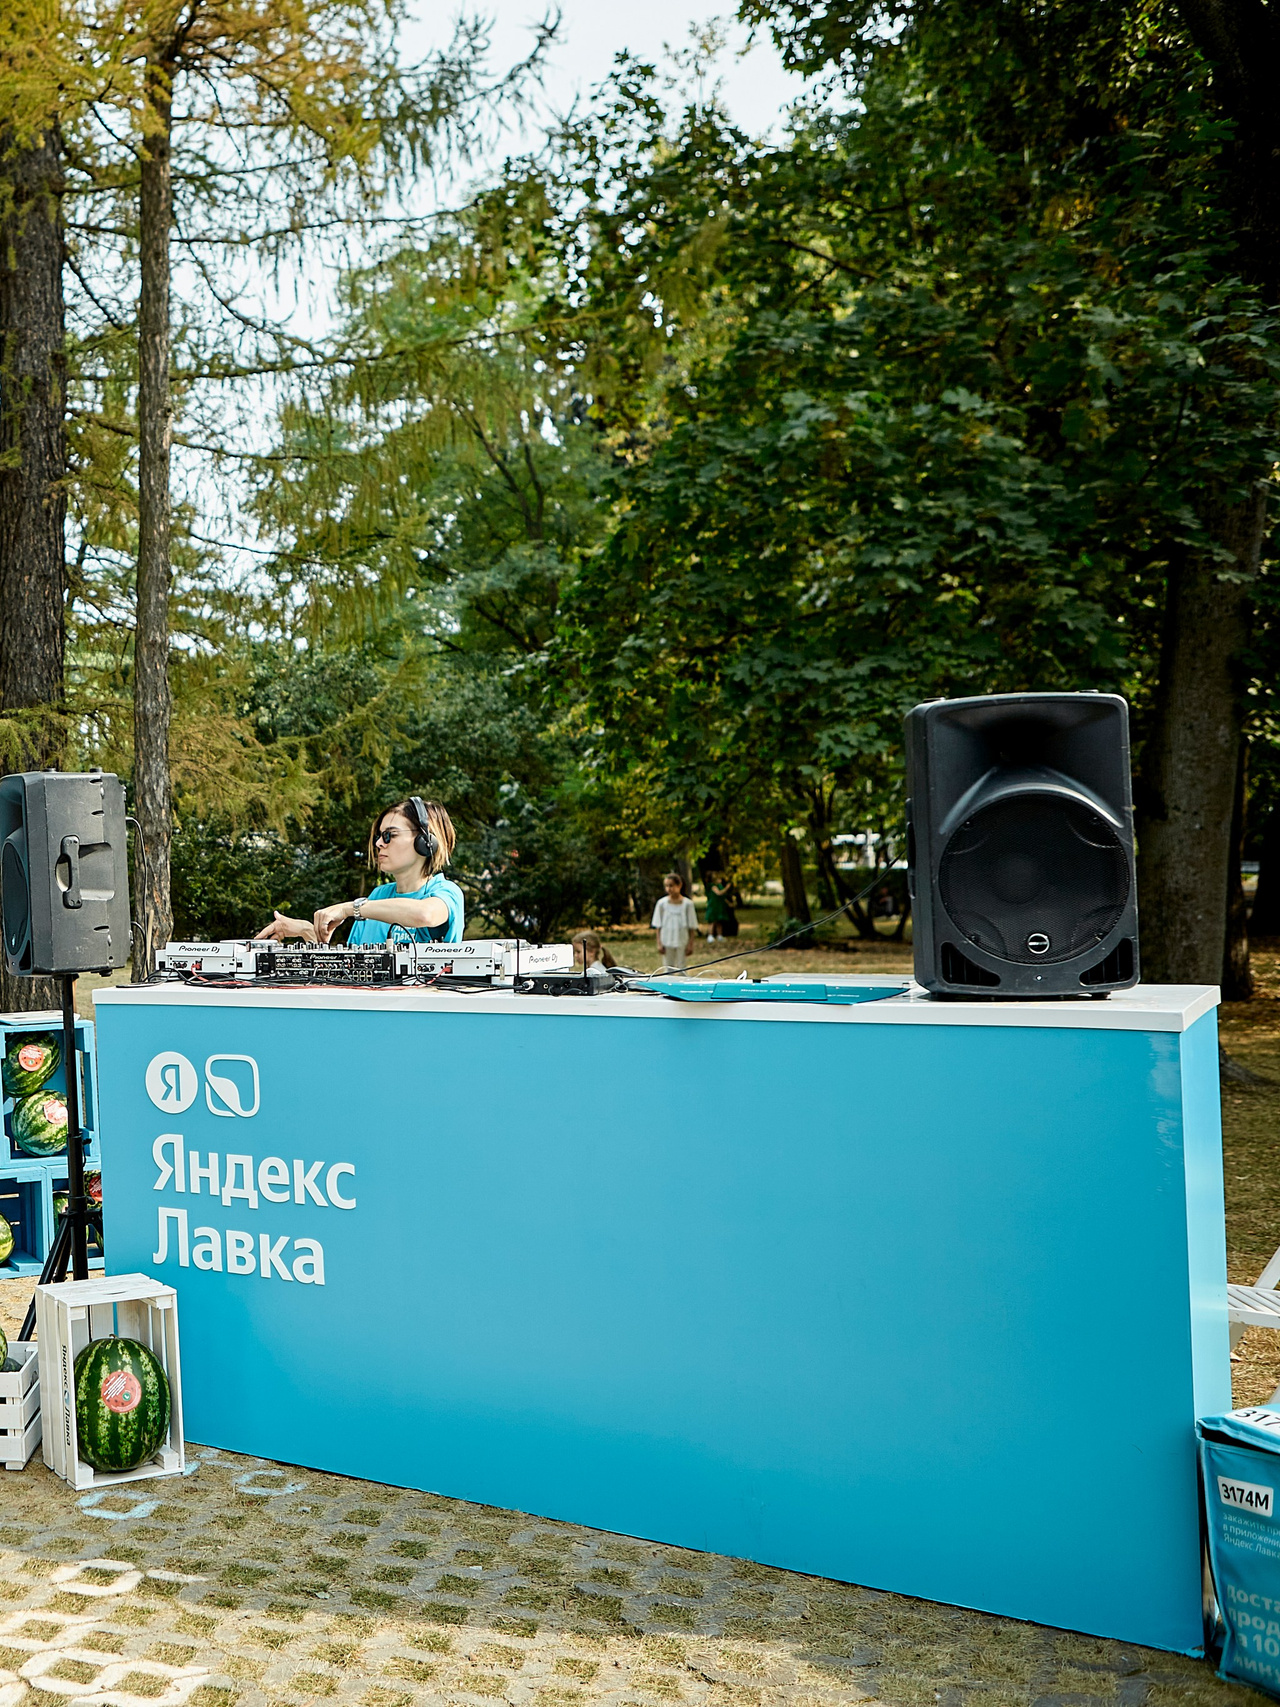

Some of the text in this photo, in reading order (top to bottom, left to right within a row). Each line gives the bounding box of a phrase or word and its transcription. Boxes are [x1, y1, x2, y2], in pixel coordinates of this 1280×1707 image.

[178, 945, 211, 953] Pioneer
[424, 946, 463, 954] Pioneer
[528, 955, 552, 964] Pioneer
[152, 1133, 357, 1210] Яндекс
[152, 1206, 326, 1286] Лавка
[61, 1344, 70, 1388] Яндекс
[1222, 1512, 1266, 1532] закажите
[1223, 1533, 1254, 1551] Яндекс
[1230, 1525, 1280, 1549] приложени
